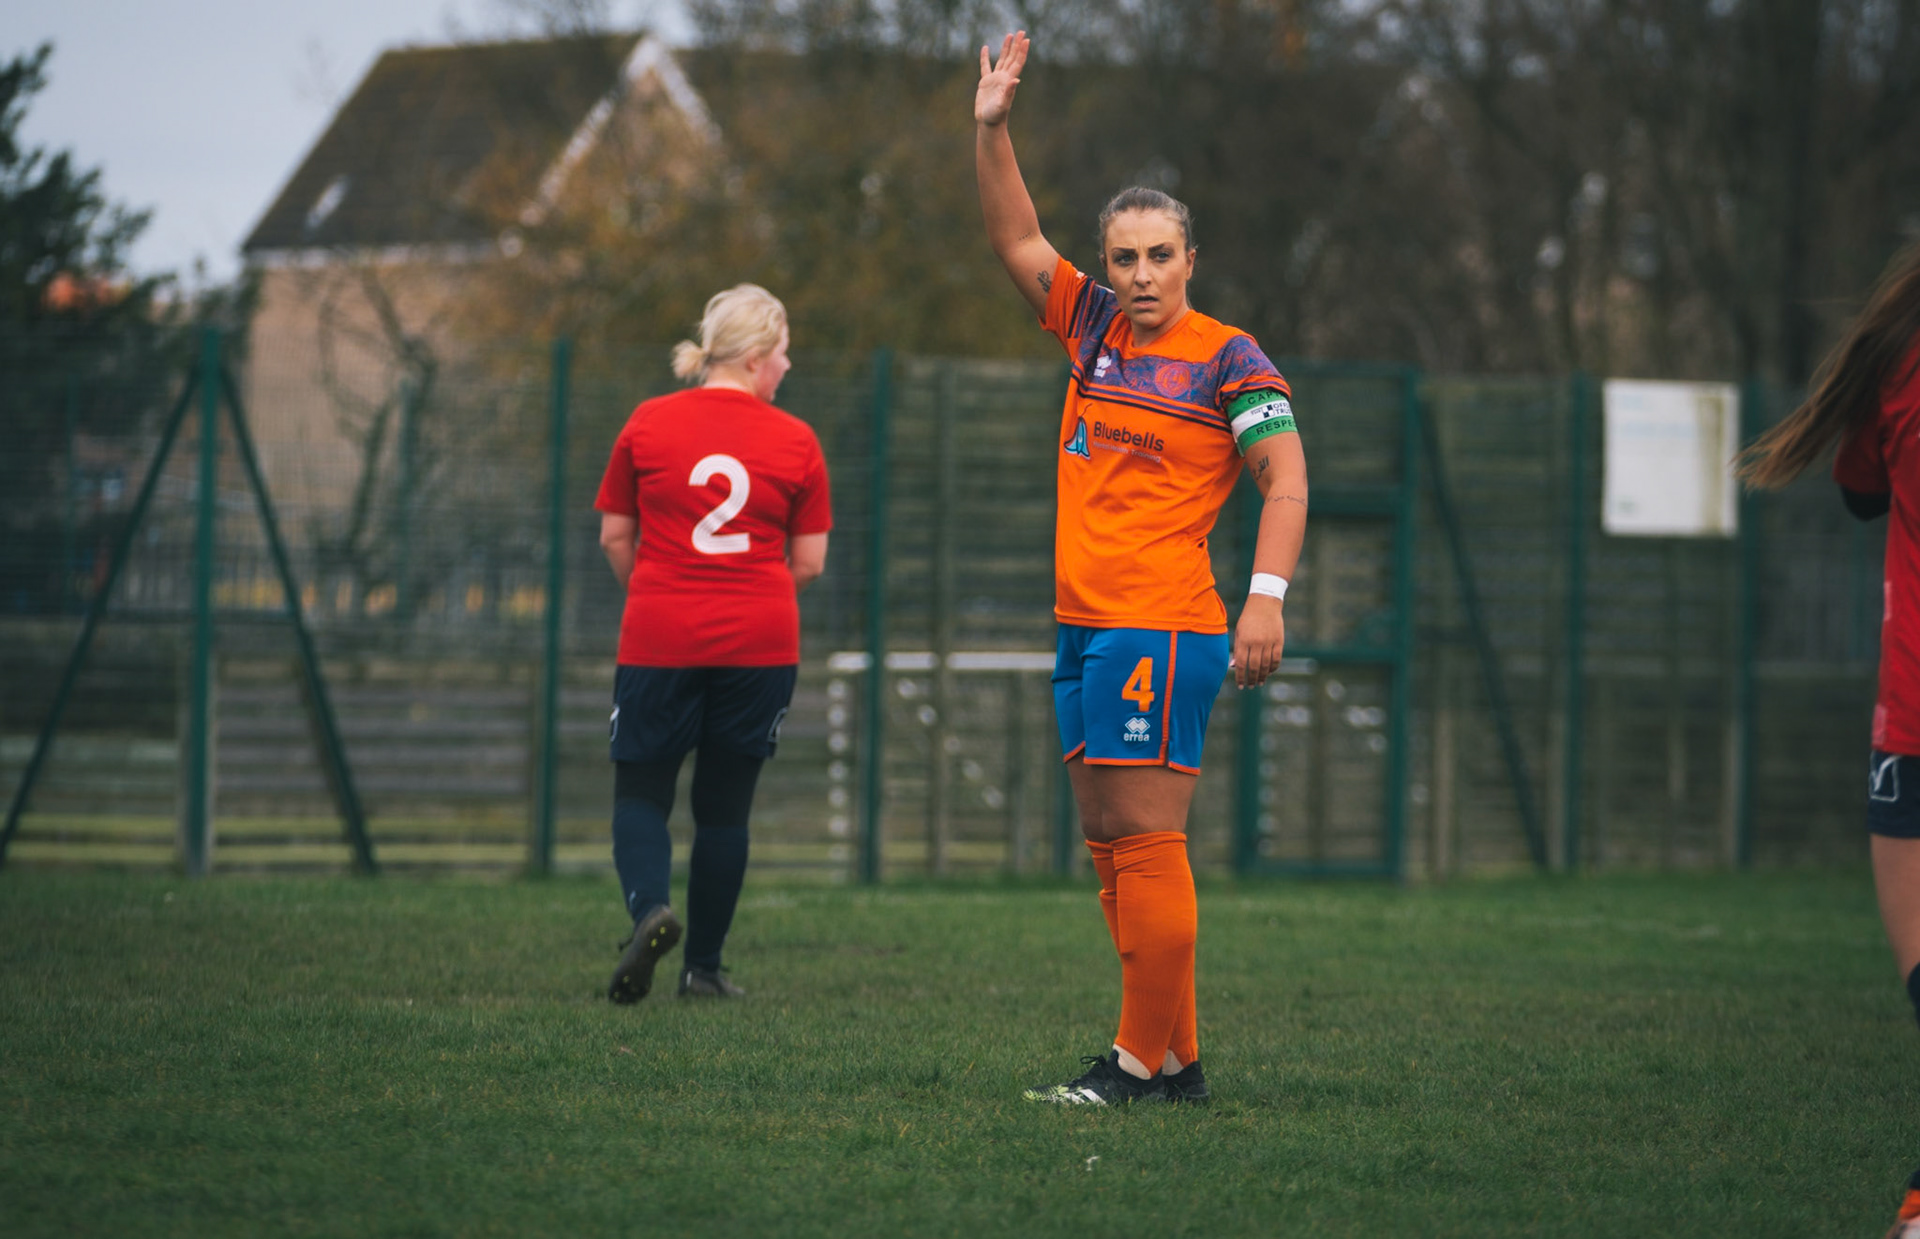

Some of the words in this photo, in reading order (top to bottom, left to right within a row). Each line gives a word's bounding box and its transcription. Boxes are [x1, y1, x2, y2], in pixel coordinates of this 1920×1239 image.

[1093, 421, 1165, 452] Bluebells
[1131, 448, 1162, 463] Training
[688, 453, 750, 554] 2
[1121, 656, 1155, 713] 4
